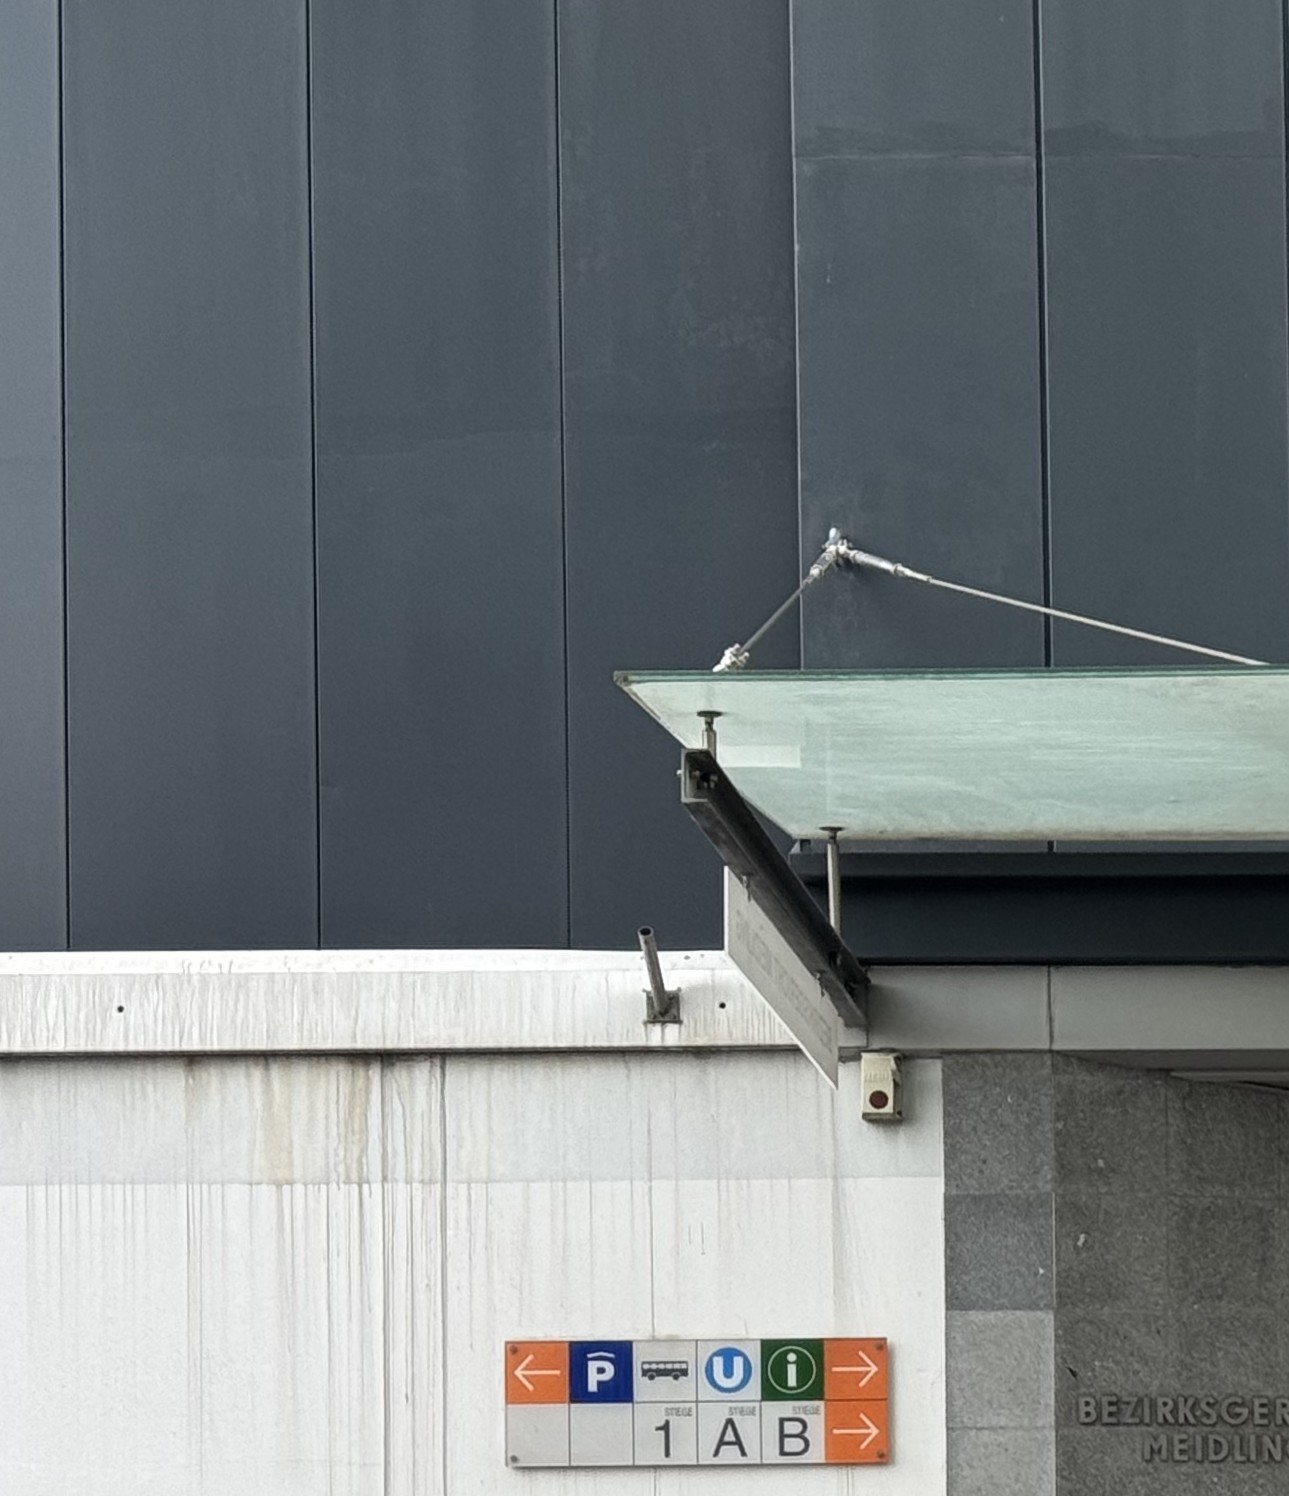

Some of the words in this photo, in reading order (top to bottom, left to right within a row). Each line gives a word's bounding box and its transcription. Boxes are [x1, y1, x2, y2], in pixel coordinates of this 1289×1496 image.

[586, 1360, 616, 1393] P
[712, 1355, 744, 1389] U
[664, 1406, 693, 1417] STIEGE
[728, 1406, 757, 1417] STIEGE
[792, 1405, 821, 1416] STIEGE
[654, 1418, 671, 1459] 1
[712, 1417, 748, 1458] A
[778, 1416, 811, 1457] B
